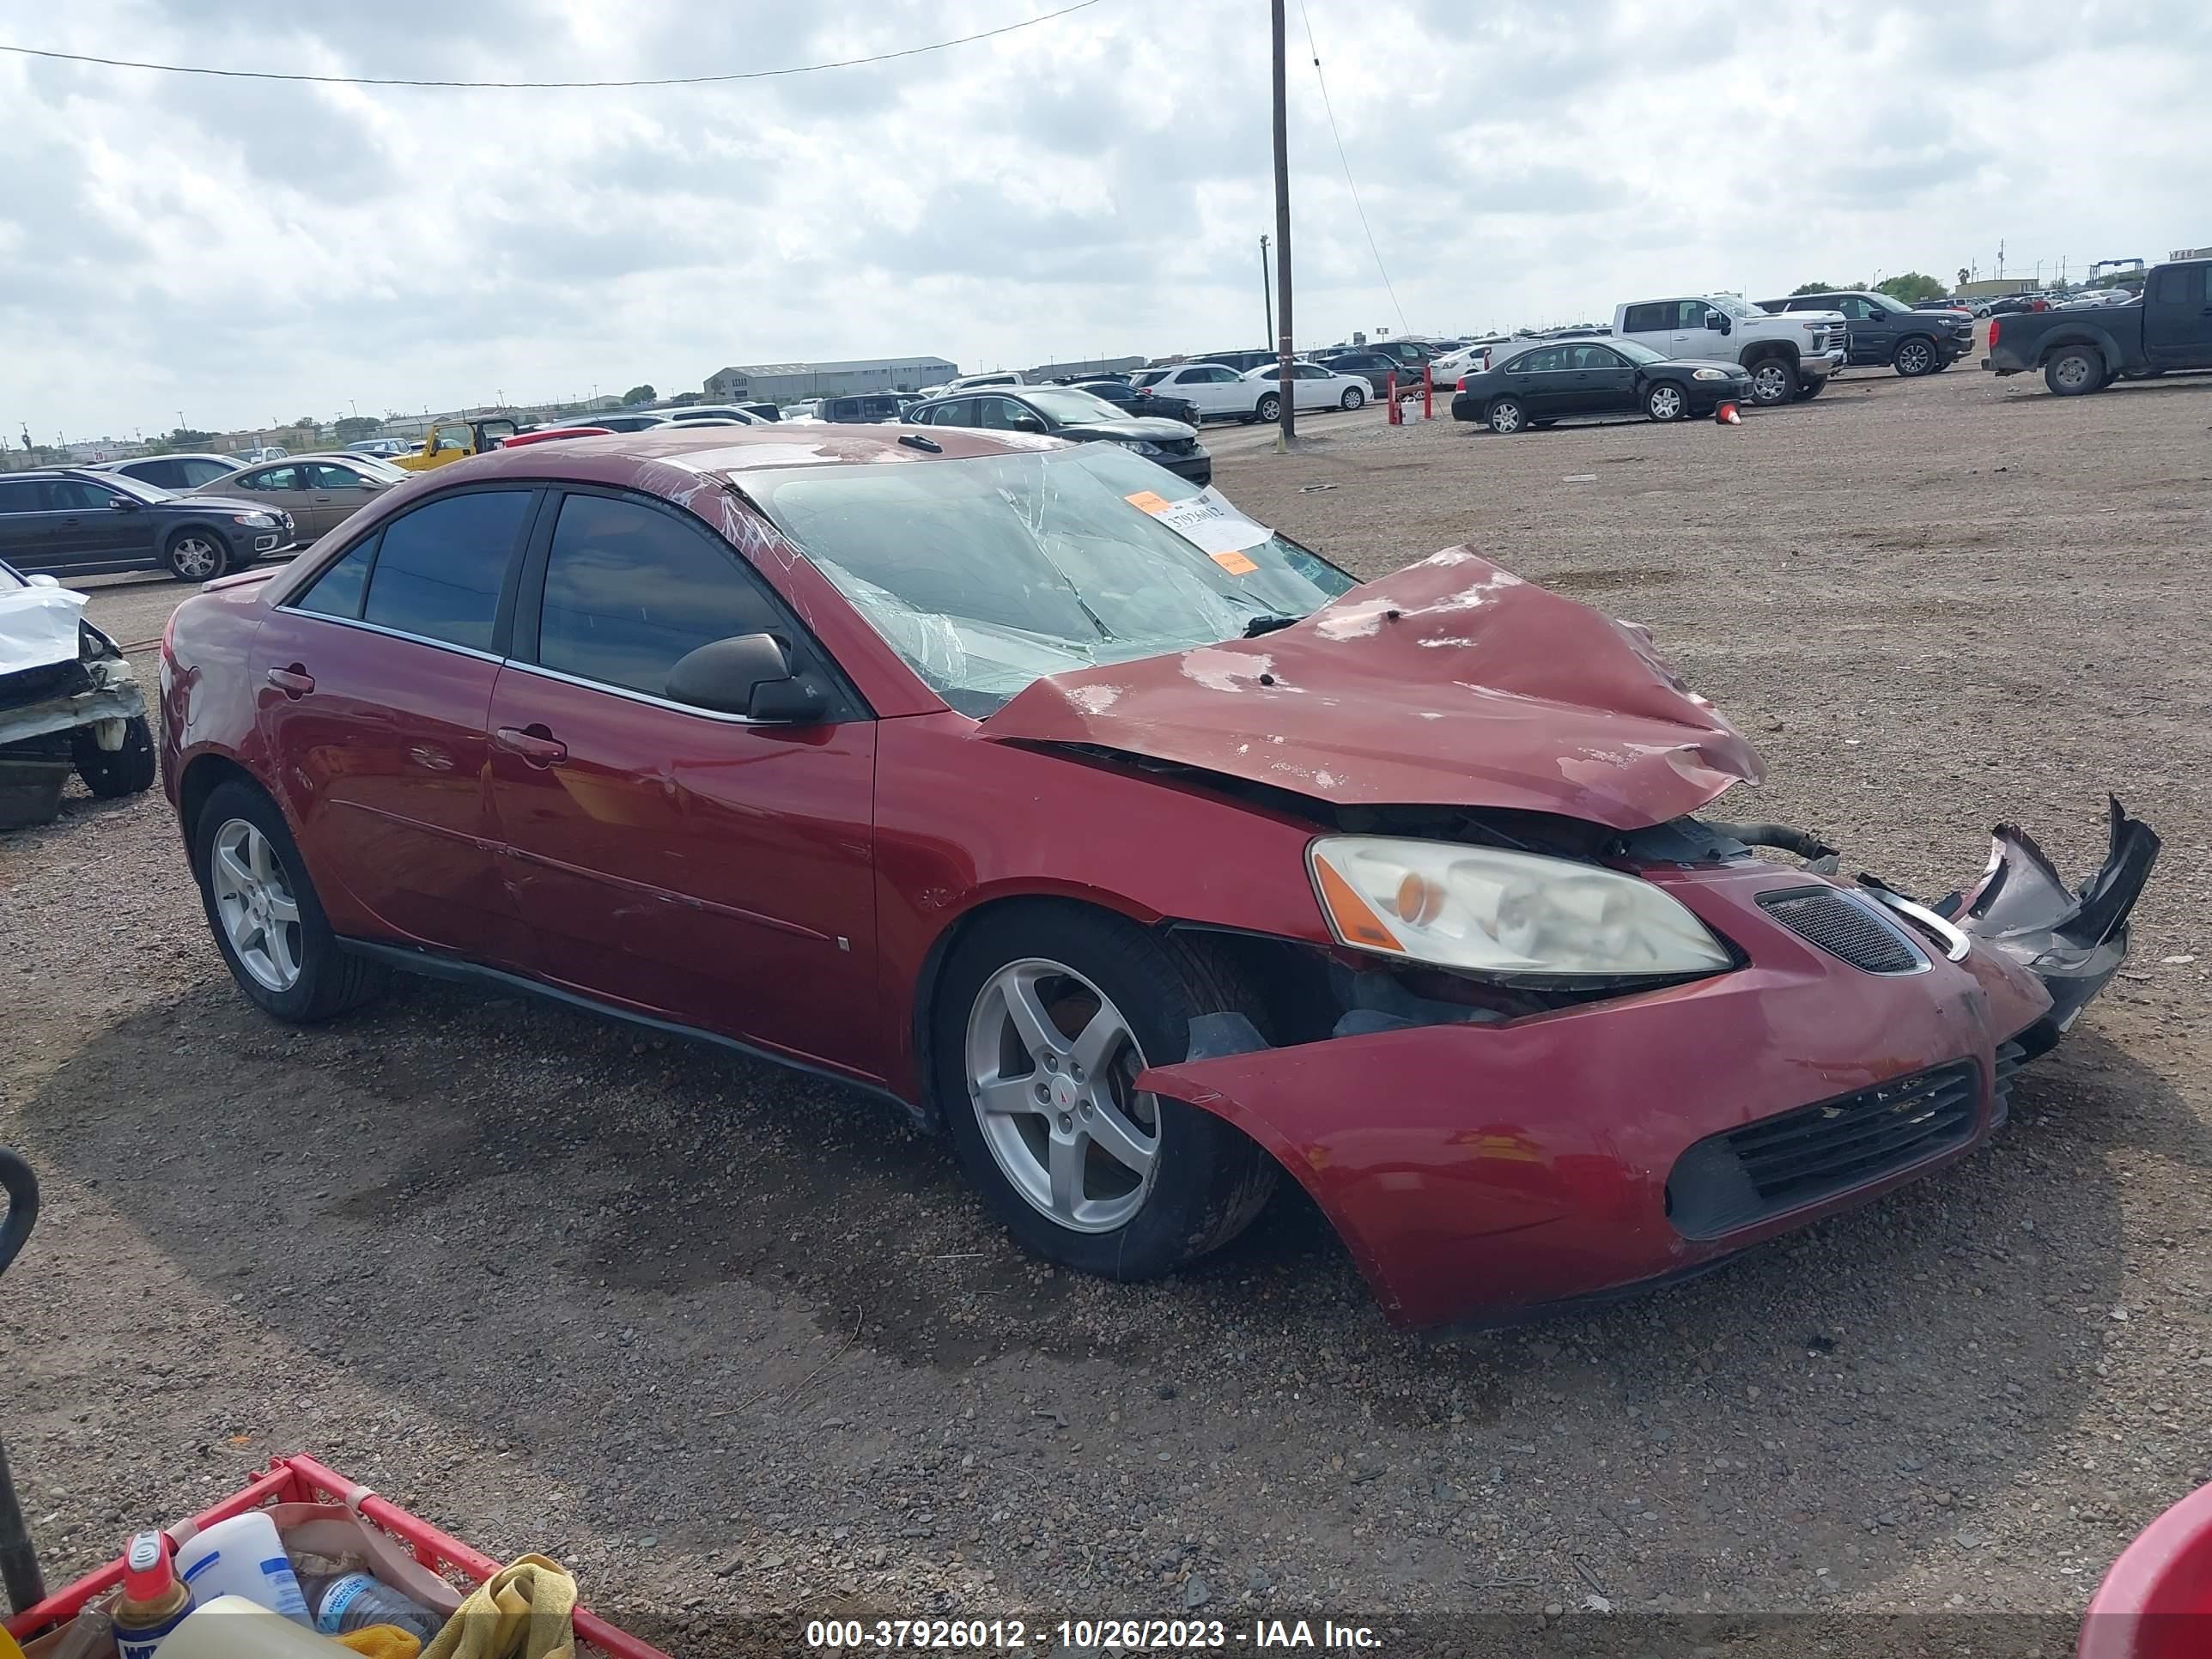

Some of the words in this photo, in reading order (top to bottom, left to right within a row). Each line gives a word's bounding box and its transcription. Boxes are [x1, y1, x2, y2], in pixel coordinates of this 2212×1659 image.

[94, 452, 104, 461] 20
[1167, 507, 1225, 528] 37926012
[328, 1578, 363, 1613] DRINKING
[336, 1583, 362, 1608] WATER
